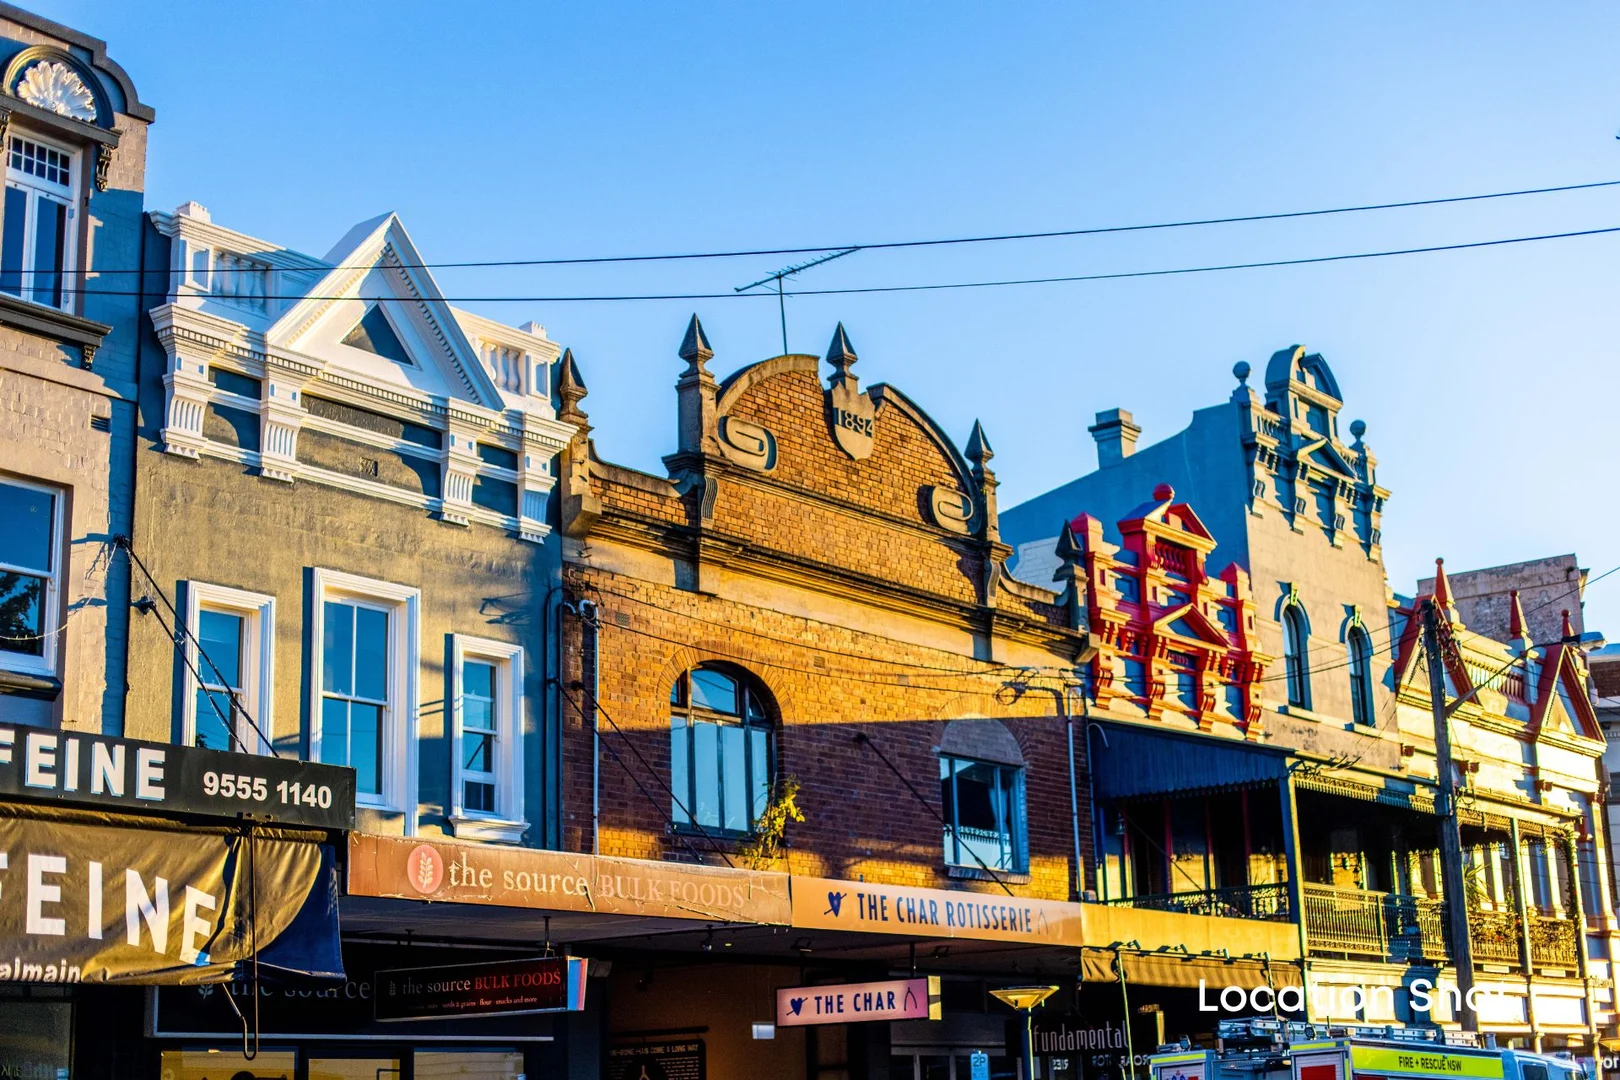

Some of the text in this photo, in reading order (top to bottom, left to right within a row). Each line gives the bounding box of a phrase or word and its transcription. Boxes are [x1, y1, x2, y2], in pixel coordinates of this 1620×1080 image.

[832, 408, 873, 438] 1894
[203, 771, 268, 801] 9555
[276, 780, 333, 809] 1140
[449, 851, 745, 908] the source BULK FOODS
[0, 853, 216, 966] EINE
[857, 892, 1032, 933] THE CHAR ROTISSERIE
[403, 970, 561, 994] the source BULK FOODS
[814, 990, 896, 1015] THE CHAR
[1033, 1019, 1129, 1052] fundamental
[972, 1056, 986, 1068] 2P
[1398, 1056, 1414, 1069] FIRE
[1421, 1057, 1446, 1071] RESCUE
[1447, 1060, 1462, 1072] NSW
